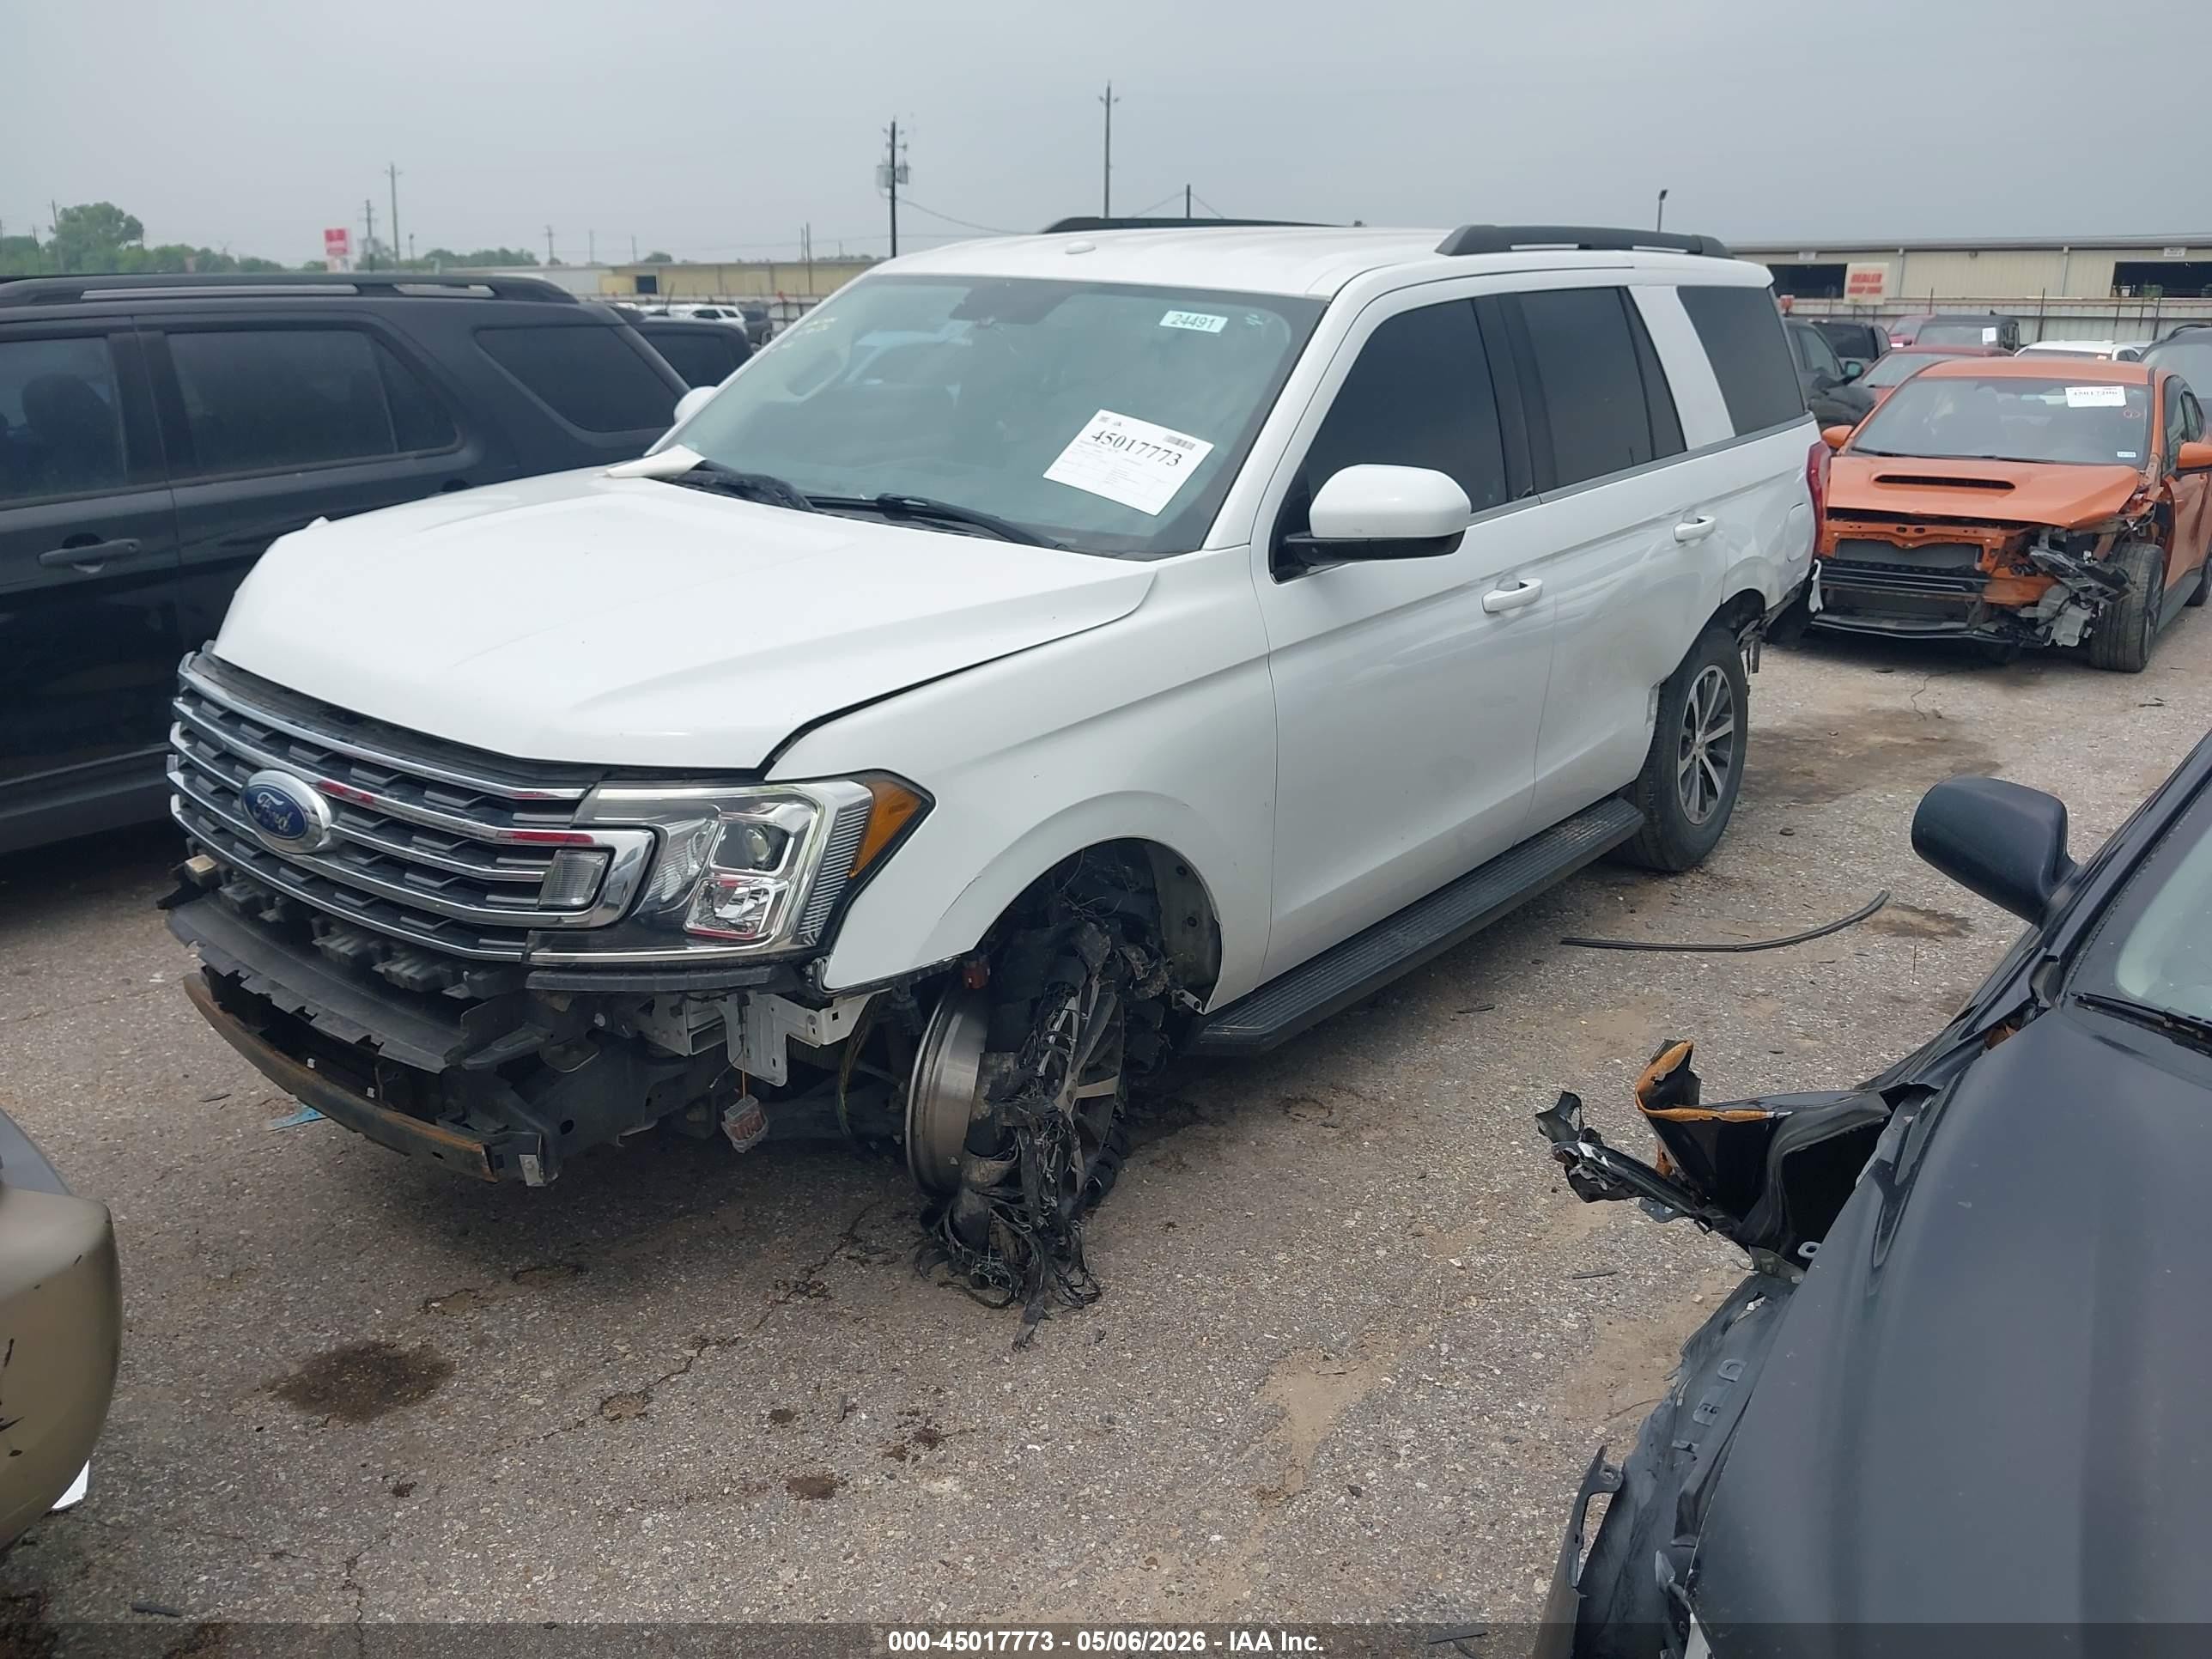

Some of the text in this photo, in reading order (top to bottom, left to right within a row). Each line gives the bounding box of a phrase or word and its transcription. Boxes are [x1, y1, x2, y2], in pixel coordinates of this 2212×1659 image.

[1170, 313, 1216, 330] 24491
[1091, 430, 1182, 467] 45017773
[252, 791, 294, 833] Ford
